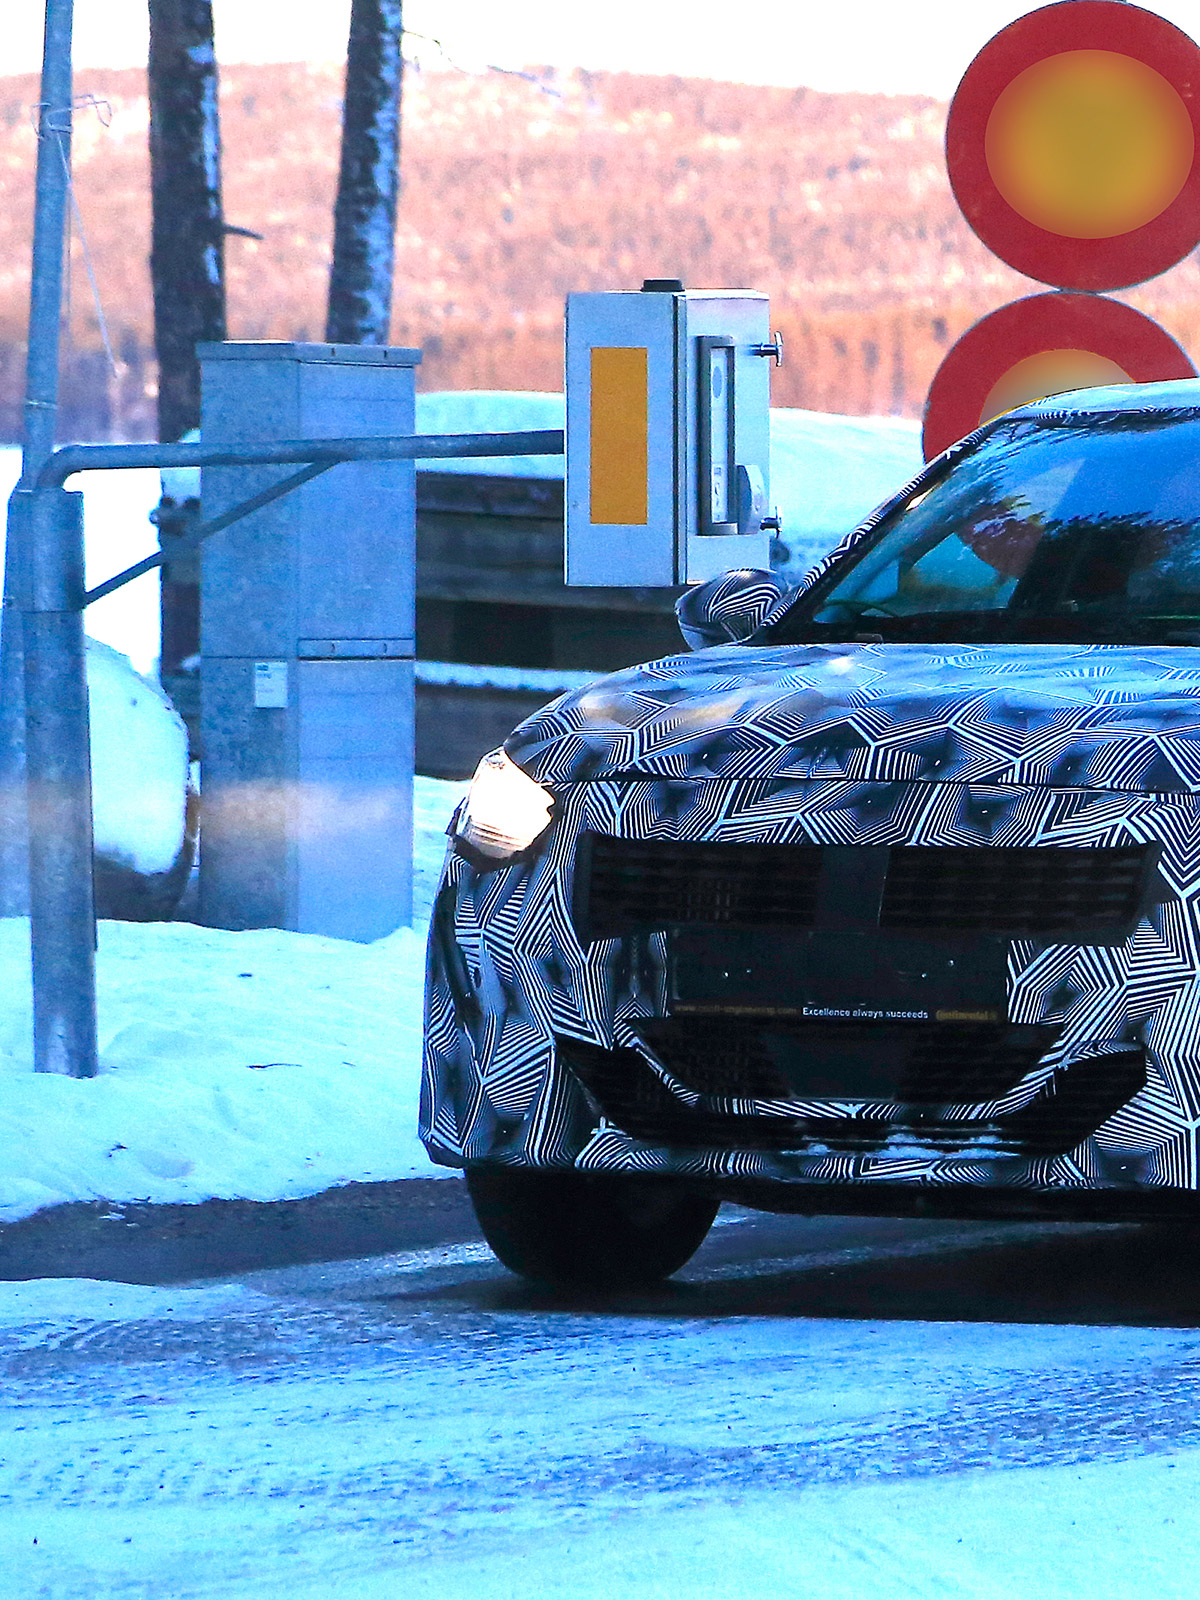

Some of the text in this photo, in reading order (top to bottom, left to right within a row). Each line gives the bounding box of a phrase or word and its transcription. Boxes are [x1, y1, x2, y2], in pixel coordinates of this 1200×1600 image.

[802, 1007, 929, 1019] Excellence always succeeds
